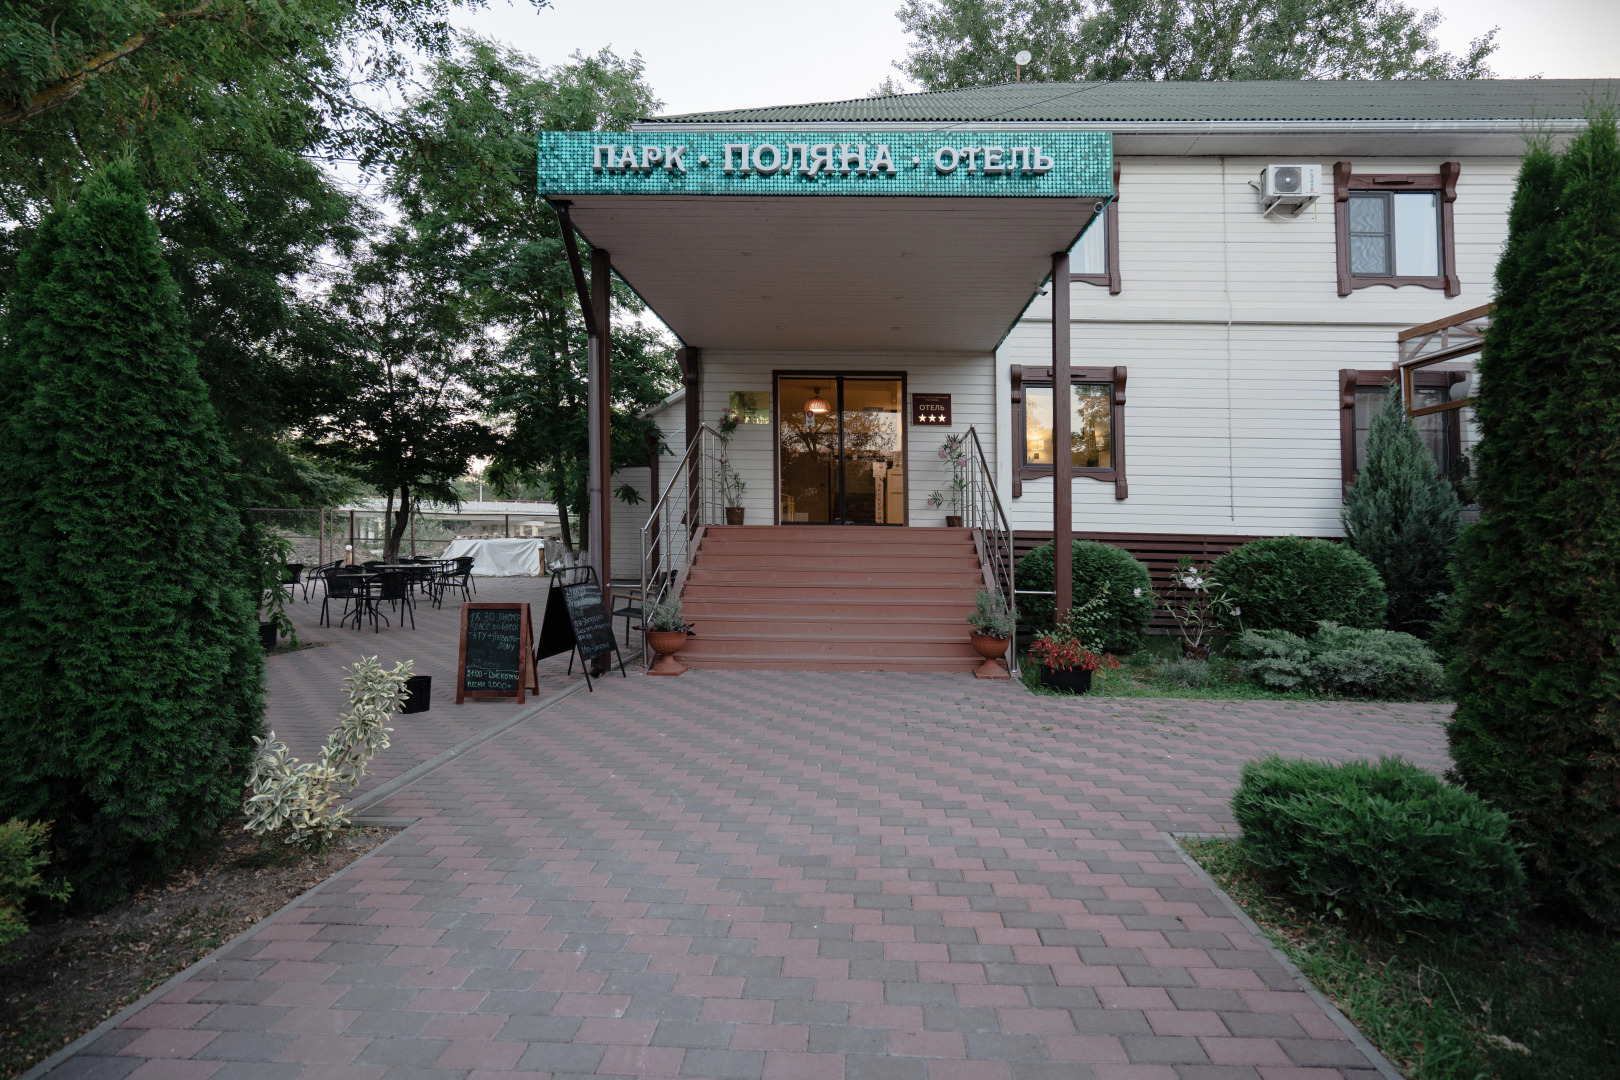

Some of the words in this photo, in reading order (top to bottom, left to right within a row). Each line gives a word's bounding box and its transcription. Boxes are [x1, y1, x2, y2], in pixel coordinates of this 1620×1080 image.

[592, 144, 687, 174] ПАРК
[723, 143, 897, 178] ПОЛЯНА
[934, 145, 1054, 175] ОТЕЛЬ
